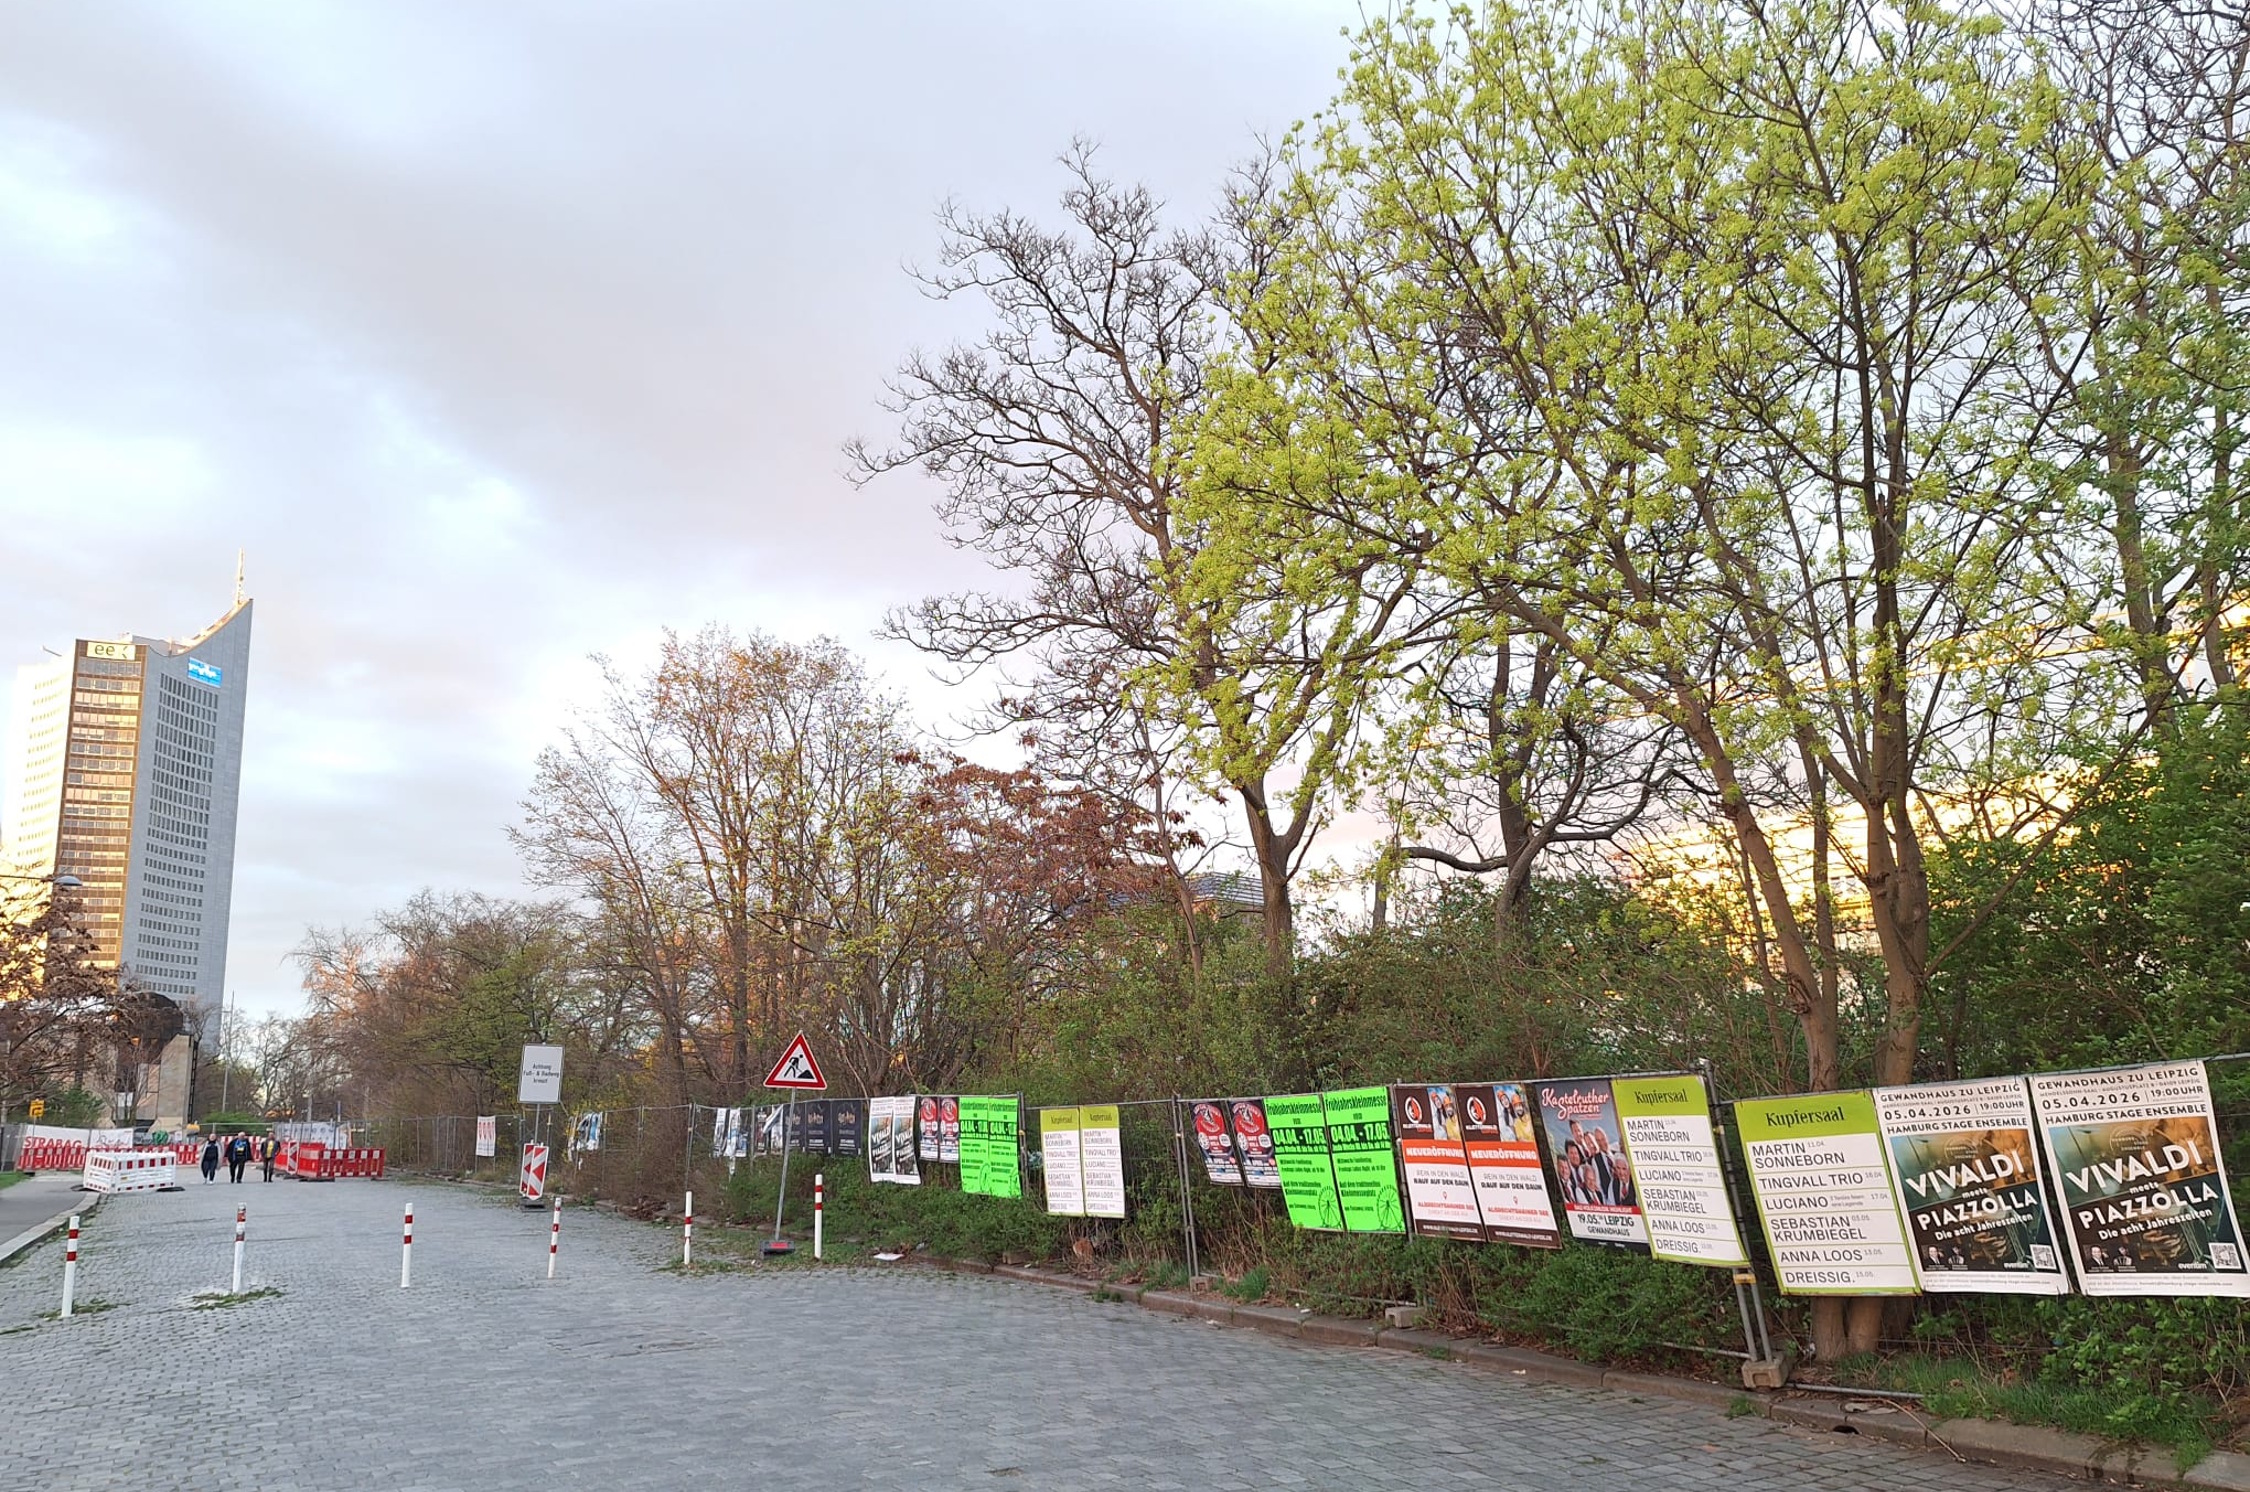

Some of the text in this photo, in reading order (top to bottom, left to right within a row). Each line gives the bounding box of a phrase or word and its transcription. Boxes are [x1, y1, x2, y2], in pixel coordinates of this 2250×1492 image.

[2037, 1067, 2198, 1090] GEWANDHAUS ZU LEIPZIG
[1634, 1088, 1688, 1106] Kupfersaal
[1880, 1090, 1956, 1102] GEWANDHAUS
[1977, 1083, 2021, 1095] LEIPZIG
[2042, 1092, 2141, 1110] 05.04.2026
[1766, 1106, 1845, 1128] Kupfersaal
[1884, 1104, 1971, 1120] 05.04.2026
[2045, 1104, 2207, 1125] HAMBURG STAGE ENSEMBLE
[1627, 1120, 1665, 1131] MARTIN
[1887, 1118, 2028, 1134] HAMBURG STAGE ENSEMBLE
[24, 1136, 82, 1148] STRABAG
[1629, 1131, 1690, 1143] SONNEBORN
[1634, 1150, 1680, 1161] TINGVALL
[1680, 1150, 1703, 1162] TRIO
[1752, 1143, 1806, 1157] MARTIN
[1755, 1152, 1845, 1169] SONNEBORN
[2065, 1139, 2203, 1194] VIVALDI
[1639, 1170, 1682, 1181] LUCIANO
[1905, 1149, 2024, 1198] VIVALDI
[1759, 1175, 1827, 1190] TINGVALL
[1828, 1172, 1863, 1186] TRIO
[2129, 1181, 2159, 1194] meets
[1644, 1188, 1696, 1201] SEBASTIAN
[1962, 1187, 1988, 1199] meets
[1646, 1200, 1708, 1214] KRUMBIEGEL
[1765, 1196, 1828, 1210] LUCIANO
[1917, 1188, 2038, 1231] PIAZZOLLA
[2078, 1182, 2219, 1230] PIAZZOLLA
[1604, 1215, 1634, 1227] LEIPZIG
[1652, 1220, 1705, 1234] ANNA LOOS
[1770, 1216, 1850, 1230] SEBASTIAN
[1935, 1213, 2034, 1241] Die acht Jahreszeiten
[2098, 1208, 2213, 1240] Die acht Jahreszeiten
[1588, 1226, 1630, 1236] GEWANDHAUS
[1774, 1228, 1867, 1242] KRUMBIEGEL
[1656, 1239, 1702, 1253] DREISSIG.
[1780, 1250, 1822, 1263] ANNA
[1824, 1250, 1863, 1262] LOOS
[1785, 1271, 1855, 1284] DREISSIG.
